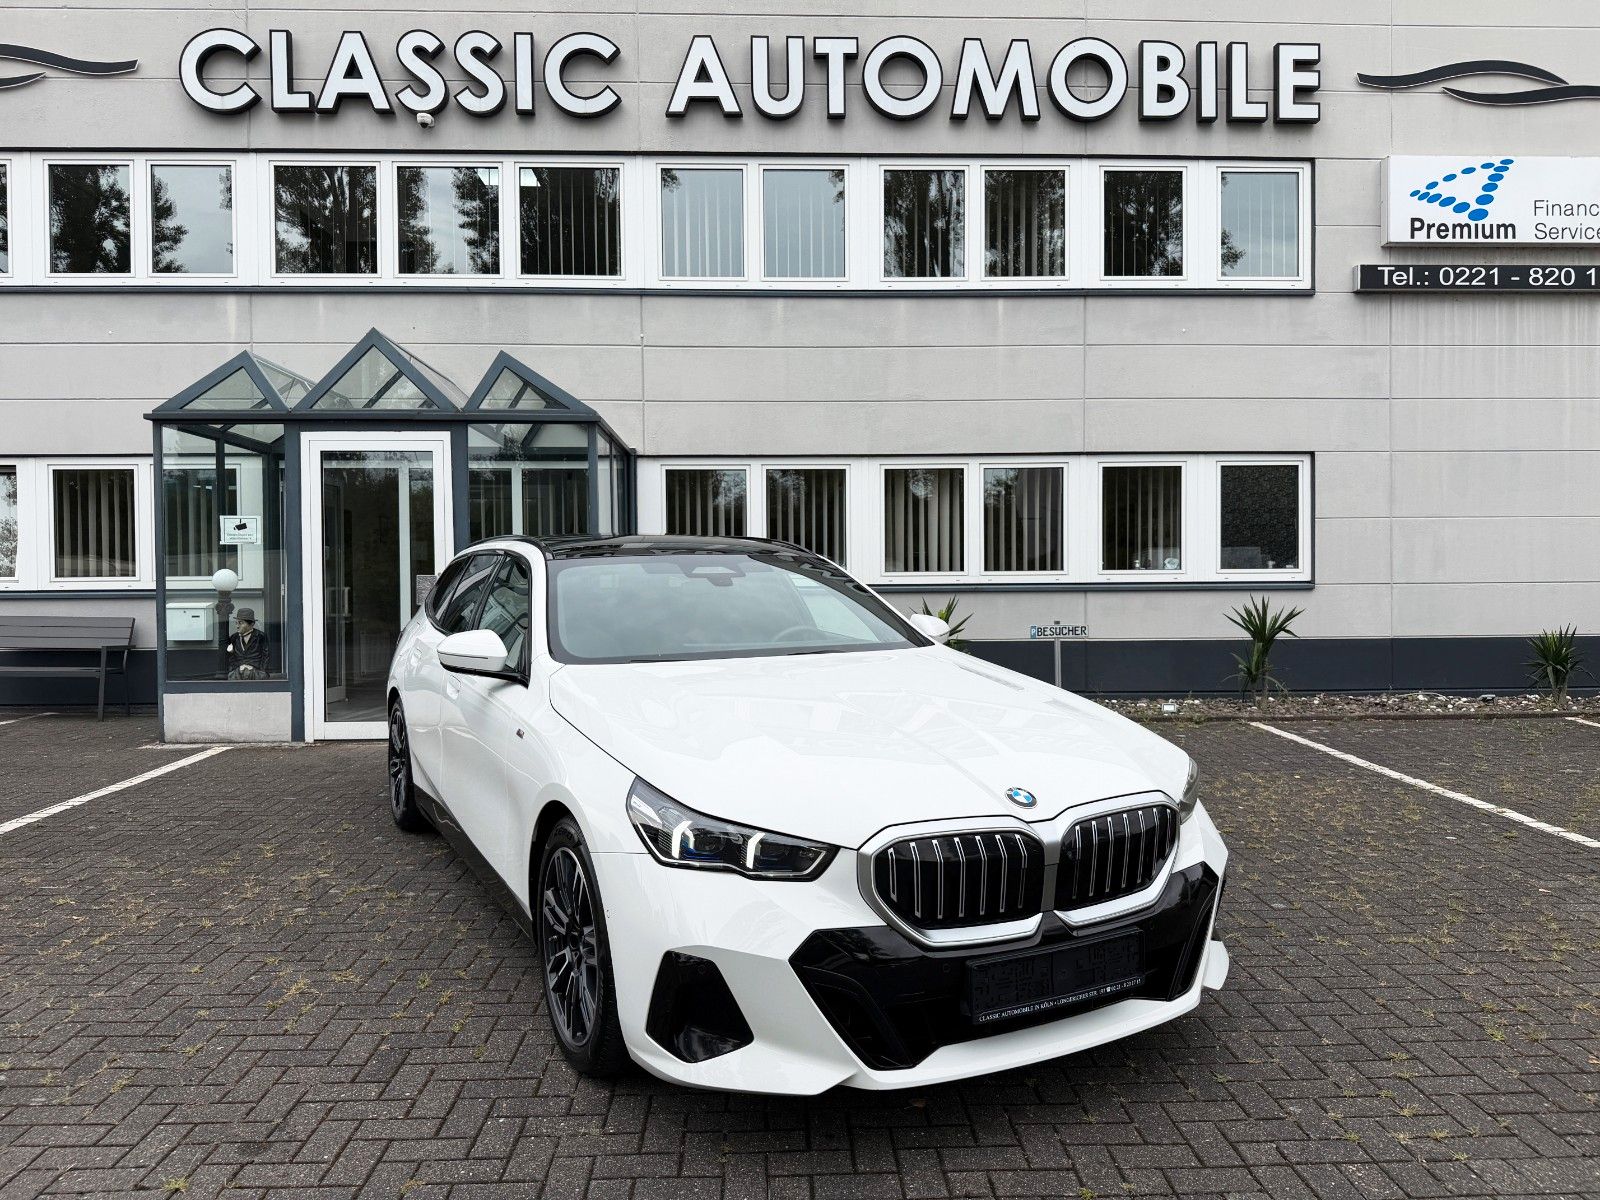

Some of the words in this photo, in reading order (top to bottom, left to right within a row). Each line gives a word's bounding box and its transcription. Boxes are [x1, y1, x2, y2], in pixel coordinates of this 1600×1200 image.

[178, 27, 622, 118] CLASSIC
[665, 34, 1321, 125] AUTOMOBILE
[1409, 217, 1517, 240] Premium
[1377, 266, 1430, 286] Tel.:
[1438, 266, 1500, 286] 0221
[1528, 267, 1576, 286] 820
[1036, 626, 1087, 637] BESUCHER
[979, 1012, 1001, 1022] CLASSIC
